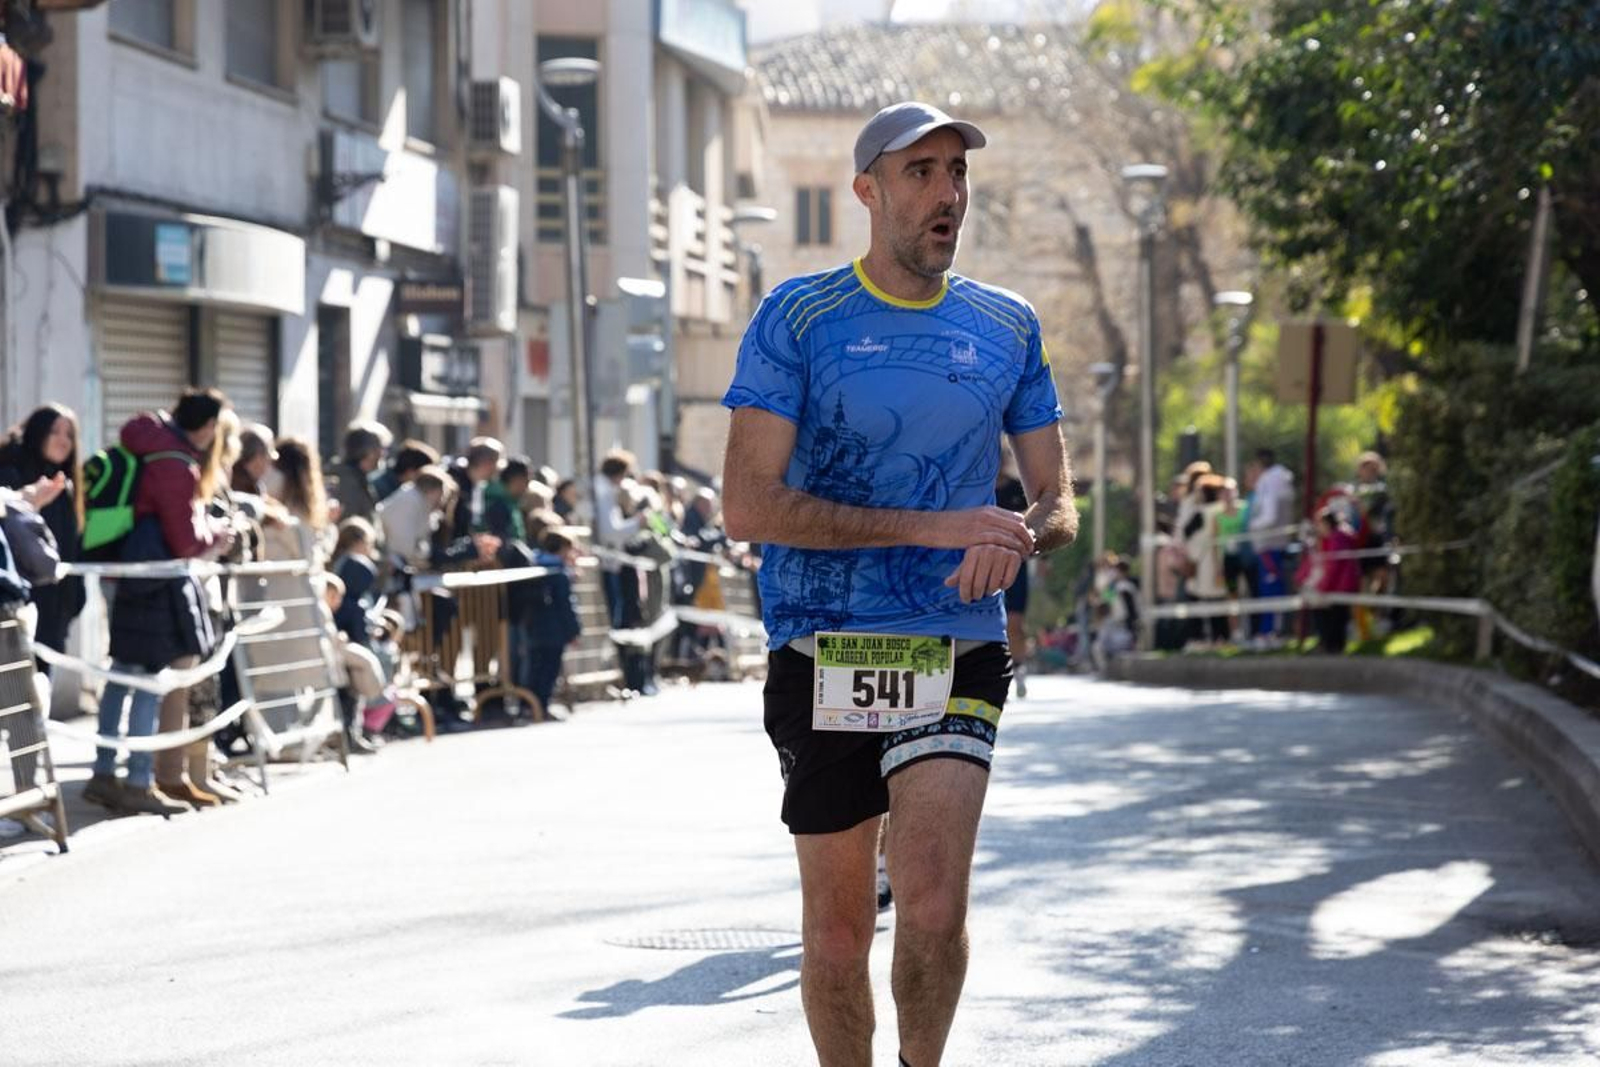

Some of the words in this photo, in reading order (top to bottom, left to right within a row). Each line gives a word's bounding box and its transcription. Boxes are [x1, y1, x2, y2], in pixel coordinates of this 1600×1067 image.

[841, 638, 857, 649] SAN
[861, 638, 882, 650] JUAN
[886, 638, 911, 650] BOSCO
[835, 650, 868, 664] CARRERA
[871, 651, 904, 664] POPULAR
[852, 669, 915, 709] 541
